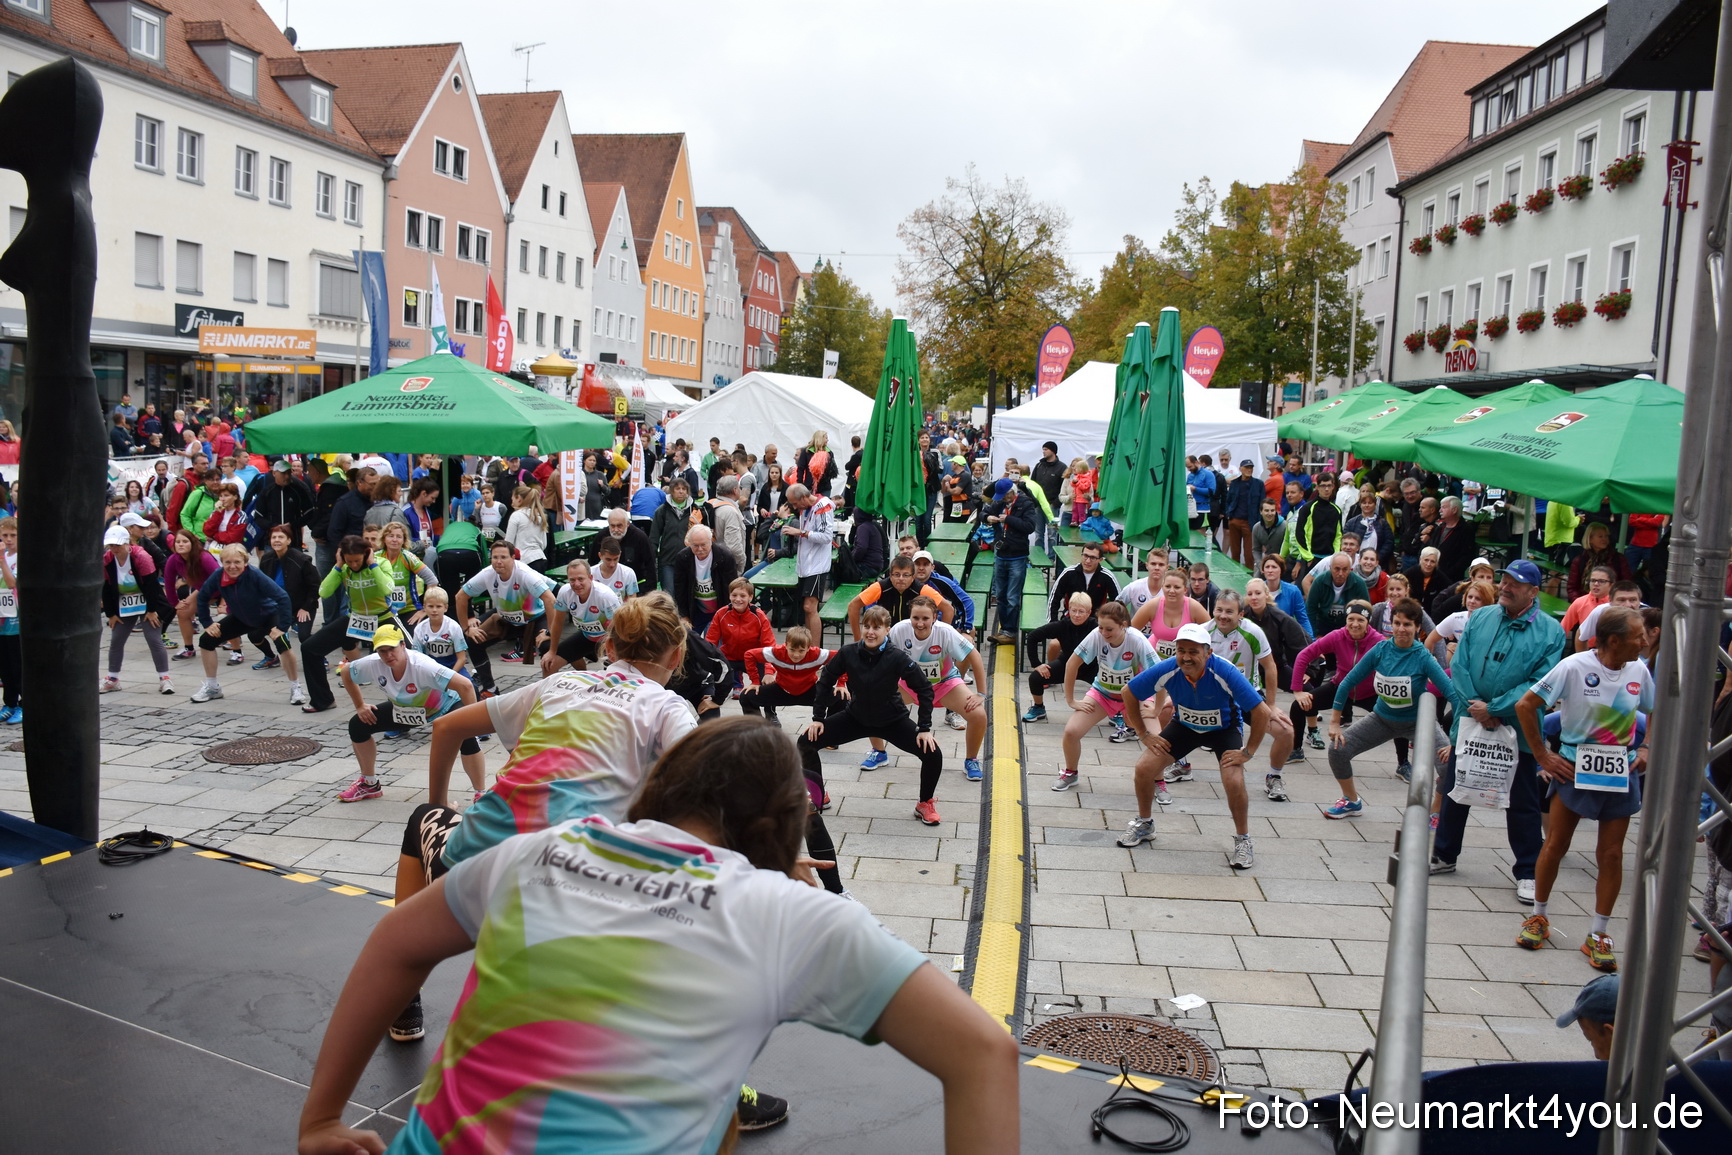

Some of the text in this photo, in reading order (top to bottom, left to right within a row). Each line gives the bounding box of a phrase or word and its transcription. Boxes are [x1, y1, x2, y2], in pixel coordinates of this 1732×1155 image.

[203, 333, 311, 350] RUNMARKT.DE
[1046, 344, 1069, 356] Hervis
[1193, 346, 1219, 357] Hervis
[1444, 348, 1477, 373] RENO
[1042, 364, 1062, 376] Hervis
[1188, 366, 1211, 377] Hervis
[365, 393, 448, 402] Neumarkter
[341, 401, 457, 412] Lammsbräu
[618, 402, 625, 411] C
[1500, 432, 1562, 448] Neumarkter
[1470, 437, 1557, 460] Lammsbräu
[121, 594, 146, 607] 3070
[352, 619, 375, 632] 2791
[427, 643, 450, 655] 4007
[1101, 671, 1131, 684] 5115
[1377, 682, 1408, 698] 5028
[1183, 712, 1218, 726] 2269
[1463, 748, 1514, 762] STADTLAUF
[1581, 754, 1625, 774] 3053
